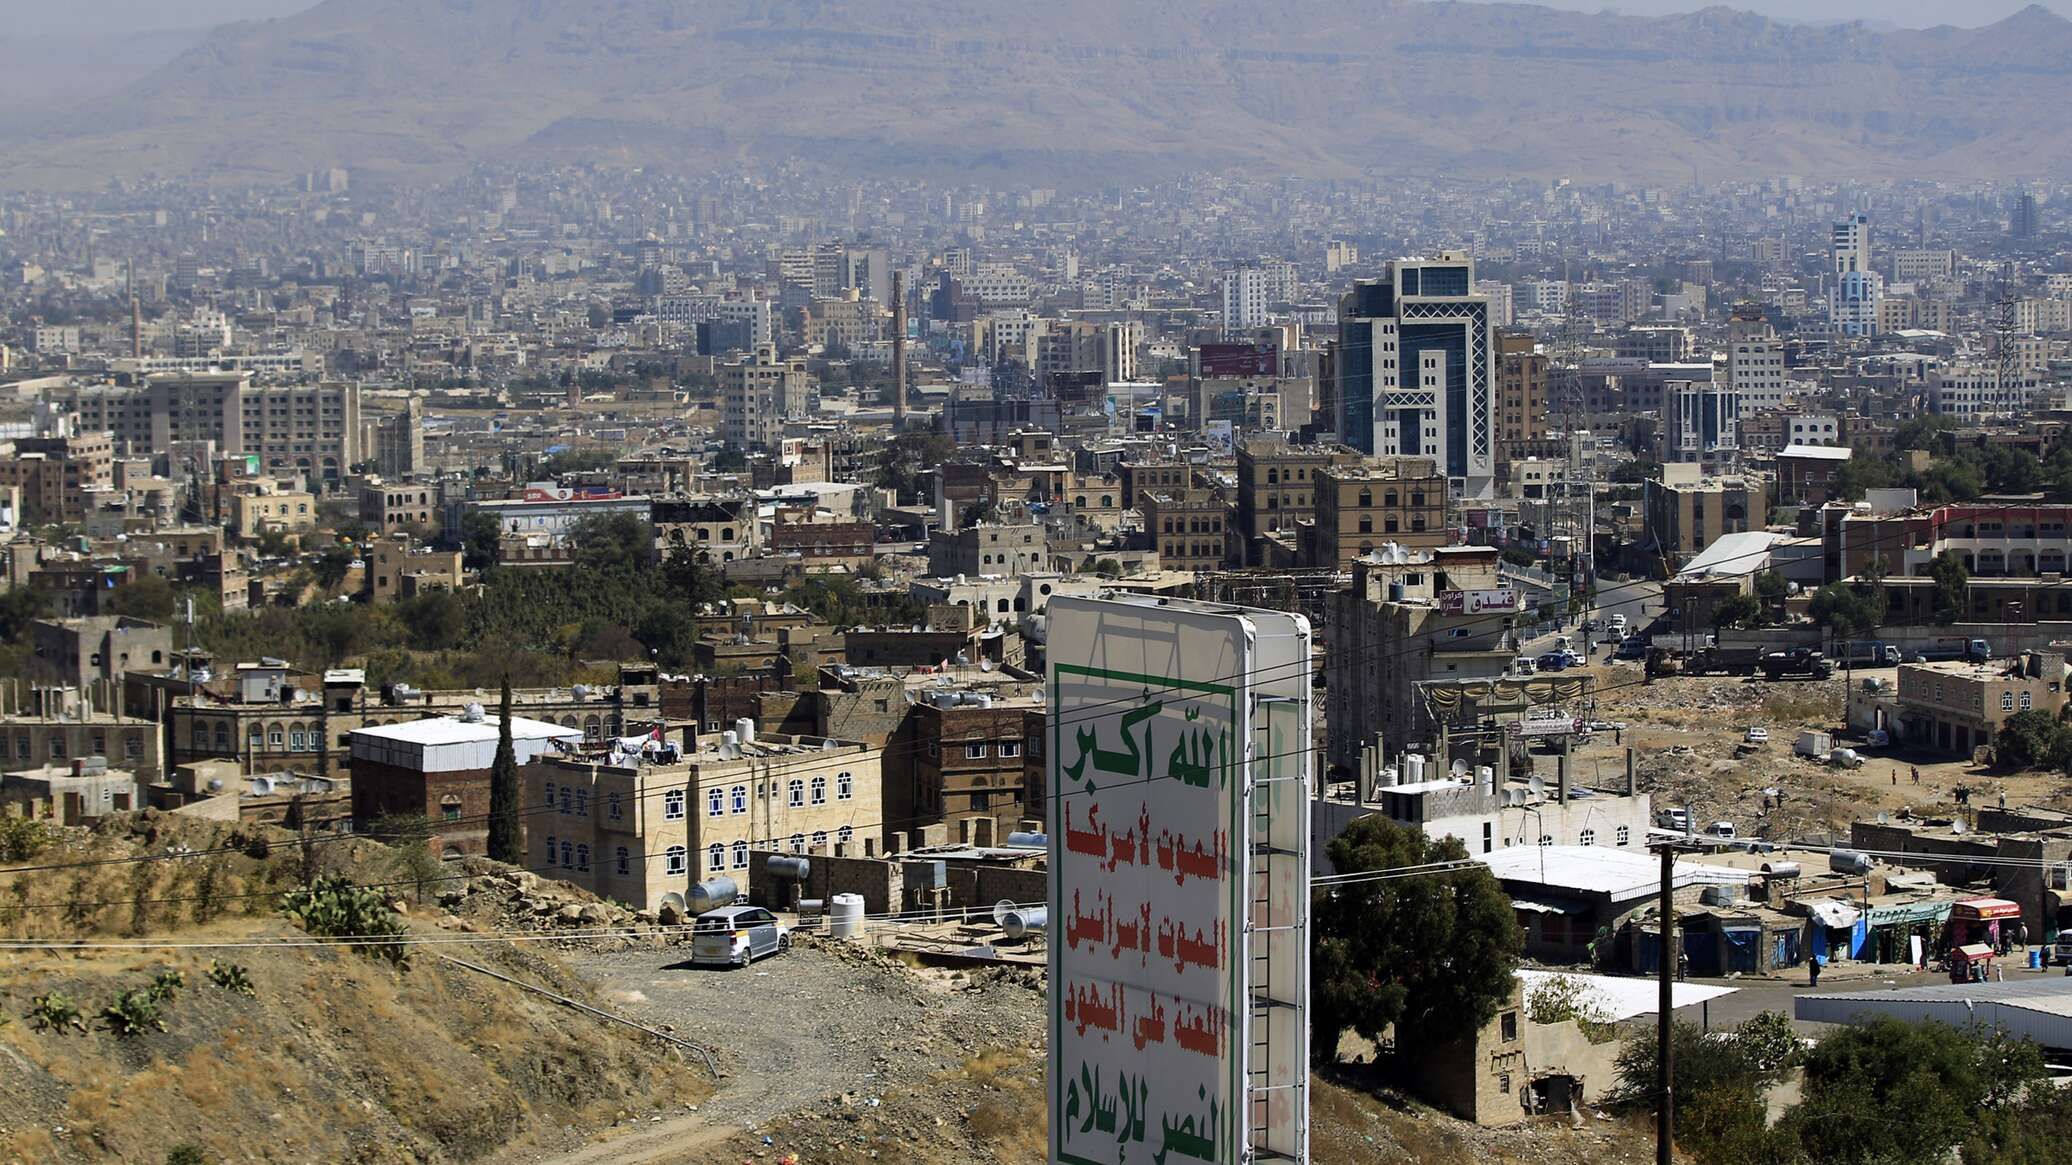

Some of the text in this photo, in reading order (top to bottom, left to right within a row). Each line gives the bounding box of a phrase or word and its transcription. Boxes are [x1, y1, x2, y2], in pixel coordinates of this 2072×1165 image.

[1471, 591, 1515, 612] فندق
[1062, 687, 1162, 796] أكبر
[1065, 801, 1226, 887] الموت لأمريكا
[1066, 888, 1226, 975] الموت لإسرائيل
[1065, 980, 1226, 1060] اللعنة على اليهود
[1066, 1058, 1148, 1164] للإسلام
[1152, 1082, 1226, 1165] النصر
